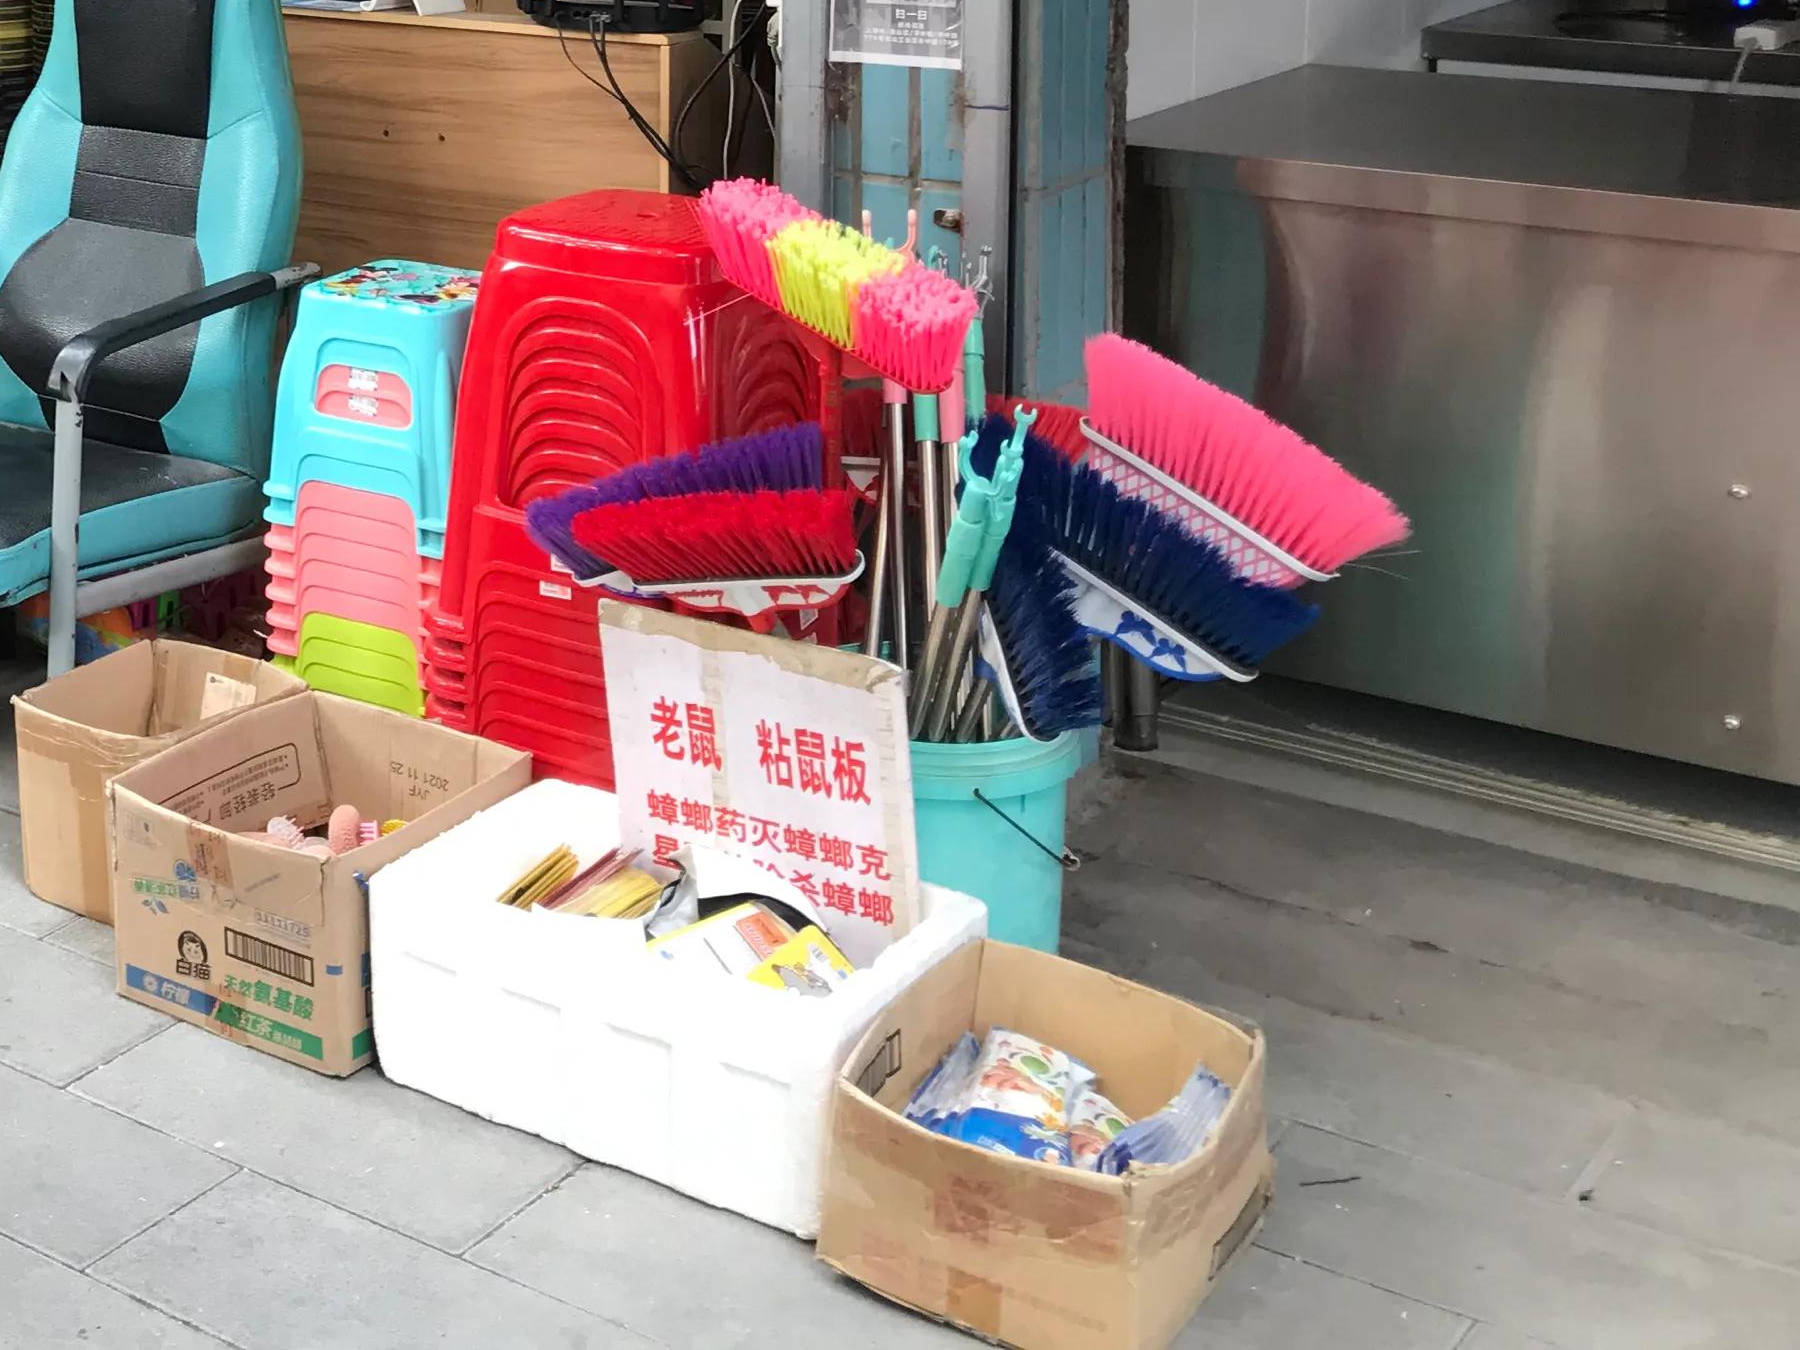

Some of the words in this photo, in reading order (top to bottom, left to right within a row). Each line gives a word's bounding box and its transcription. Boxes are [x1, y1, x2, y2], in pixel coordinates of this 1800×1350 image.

[650, 696, 722, 772] 老鼠
[755, 719, 872, 805] 粘鼠板
[390, 761, 404, 775] 25
[423, 772, 450, 792] 2021
[647, 789, 892, 881] 蟑螂药灭蟑螂克
[176, 958, 212, 980] 白猫
